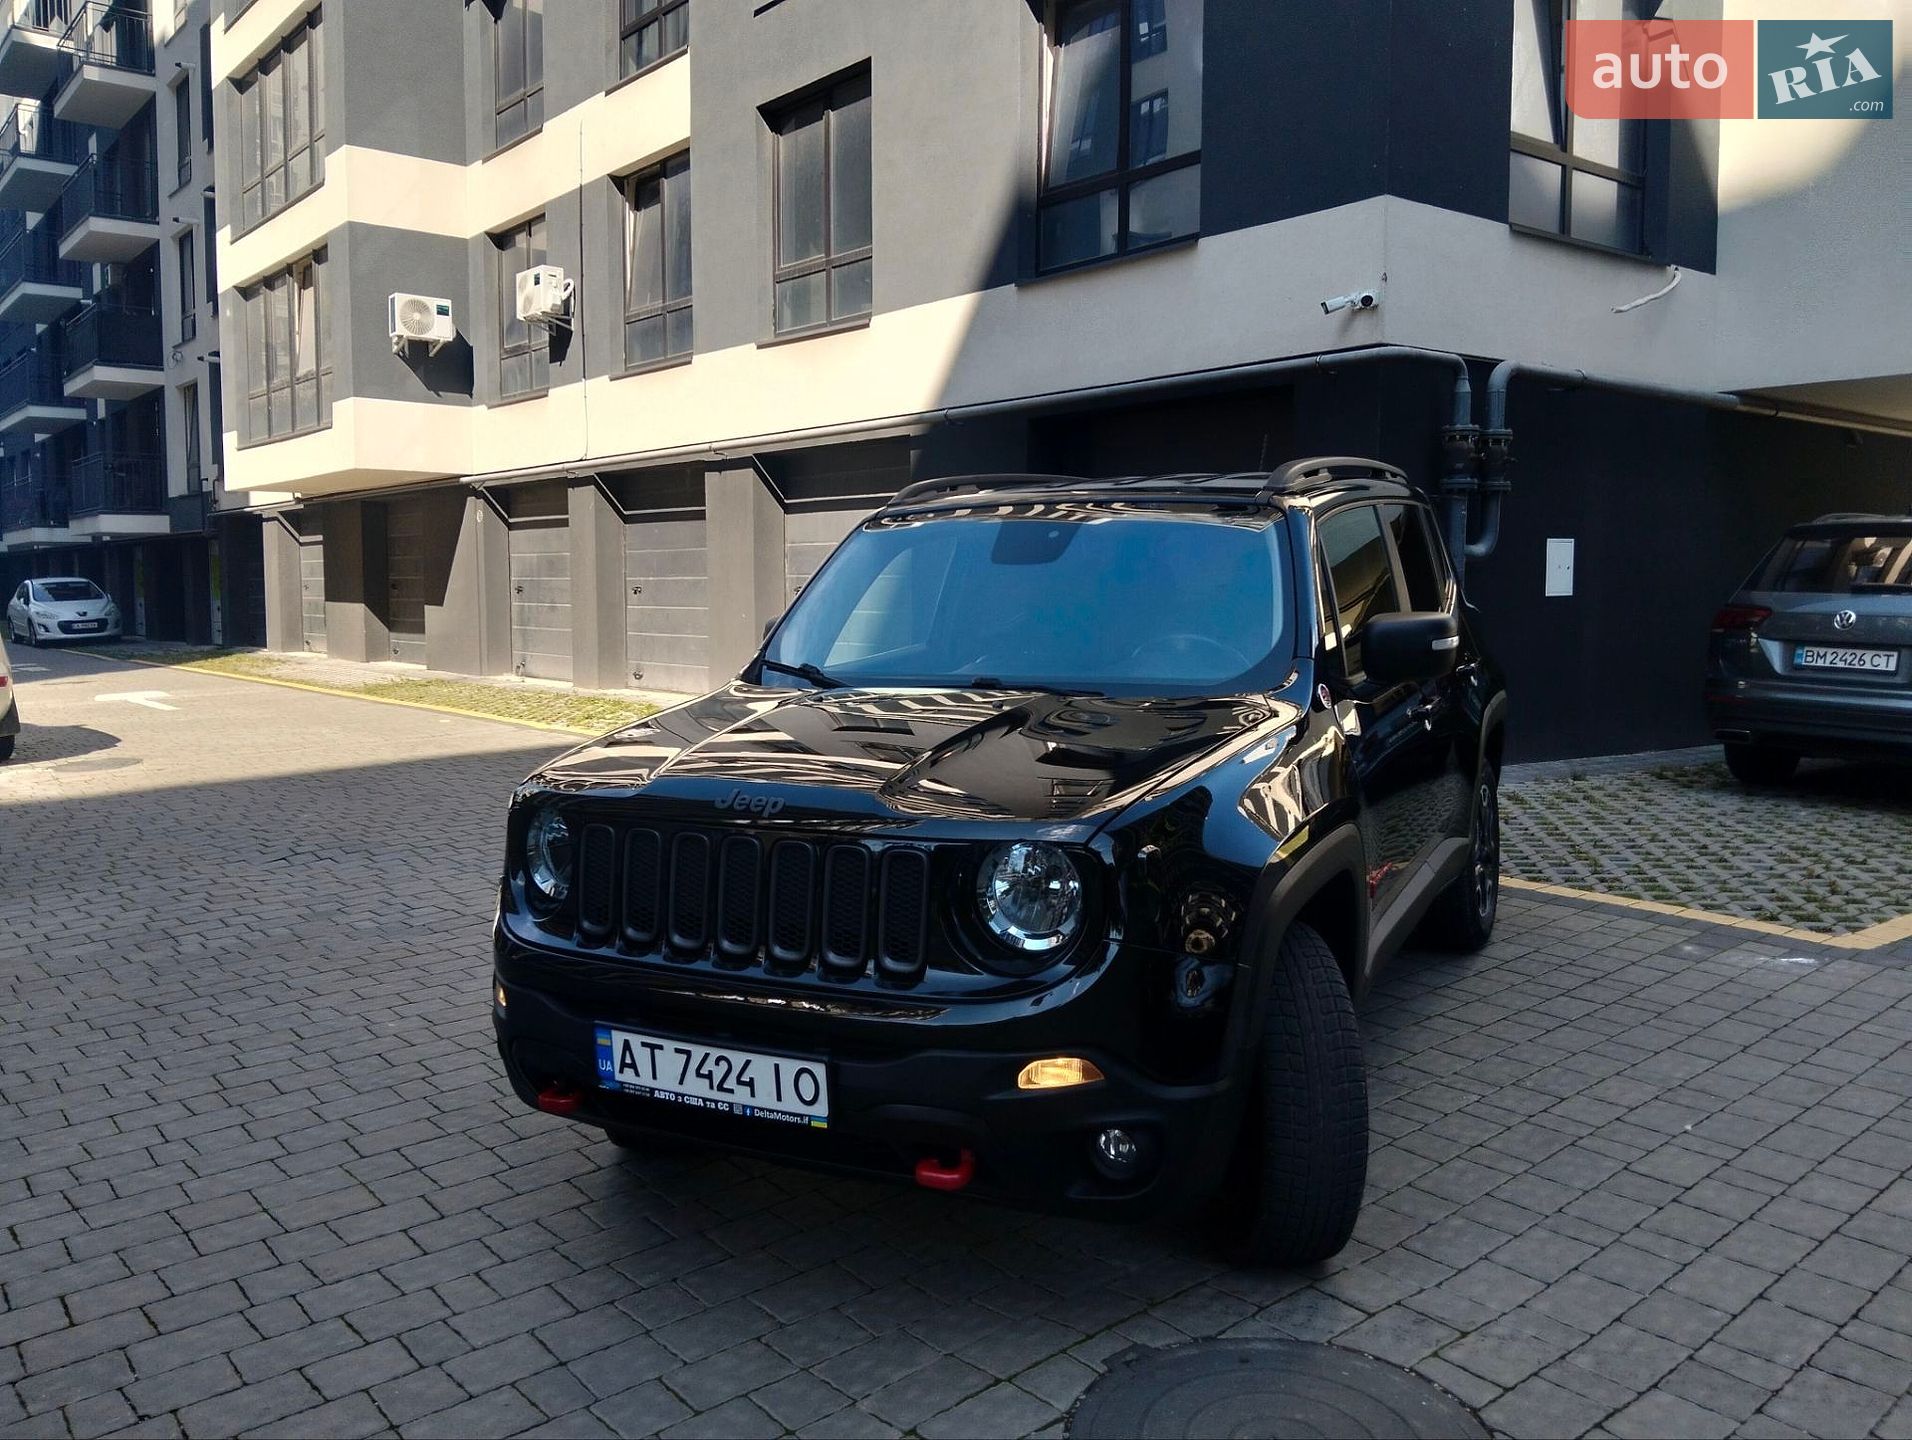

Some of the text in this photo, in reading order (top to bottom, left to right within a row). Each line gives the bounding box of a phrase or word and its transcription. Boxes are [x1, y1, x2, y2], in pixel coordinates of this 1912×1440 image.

[1804, 649, 1895, 668] BM 2426 CT
[714, 788, 785, 818] Jeep
[598, 1058, 613, 1072] UA
[618, 1038, 821, 1107] AT 7424 IO
[653, 1089, 676, 1102] АВТО
[683, 1095, 704, 1107] США
[705, 1101, 716, 1109] та
